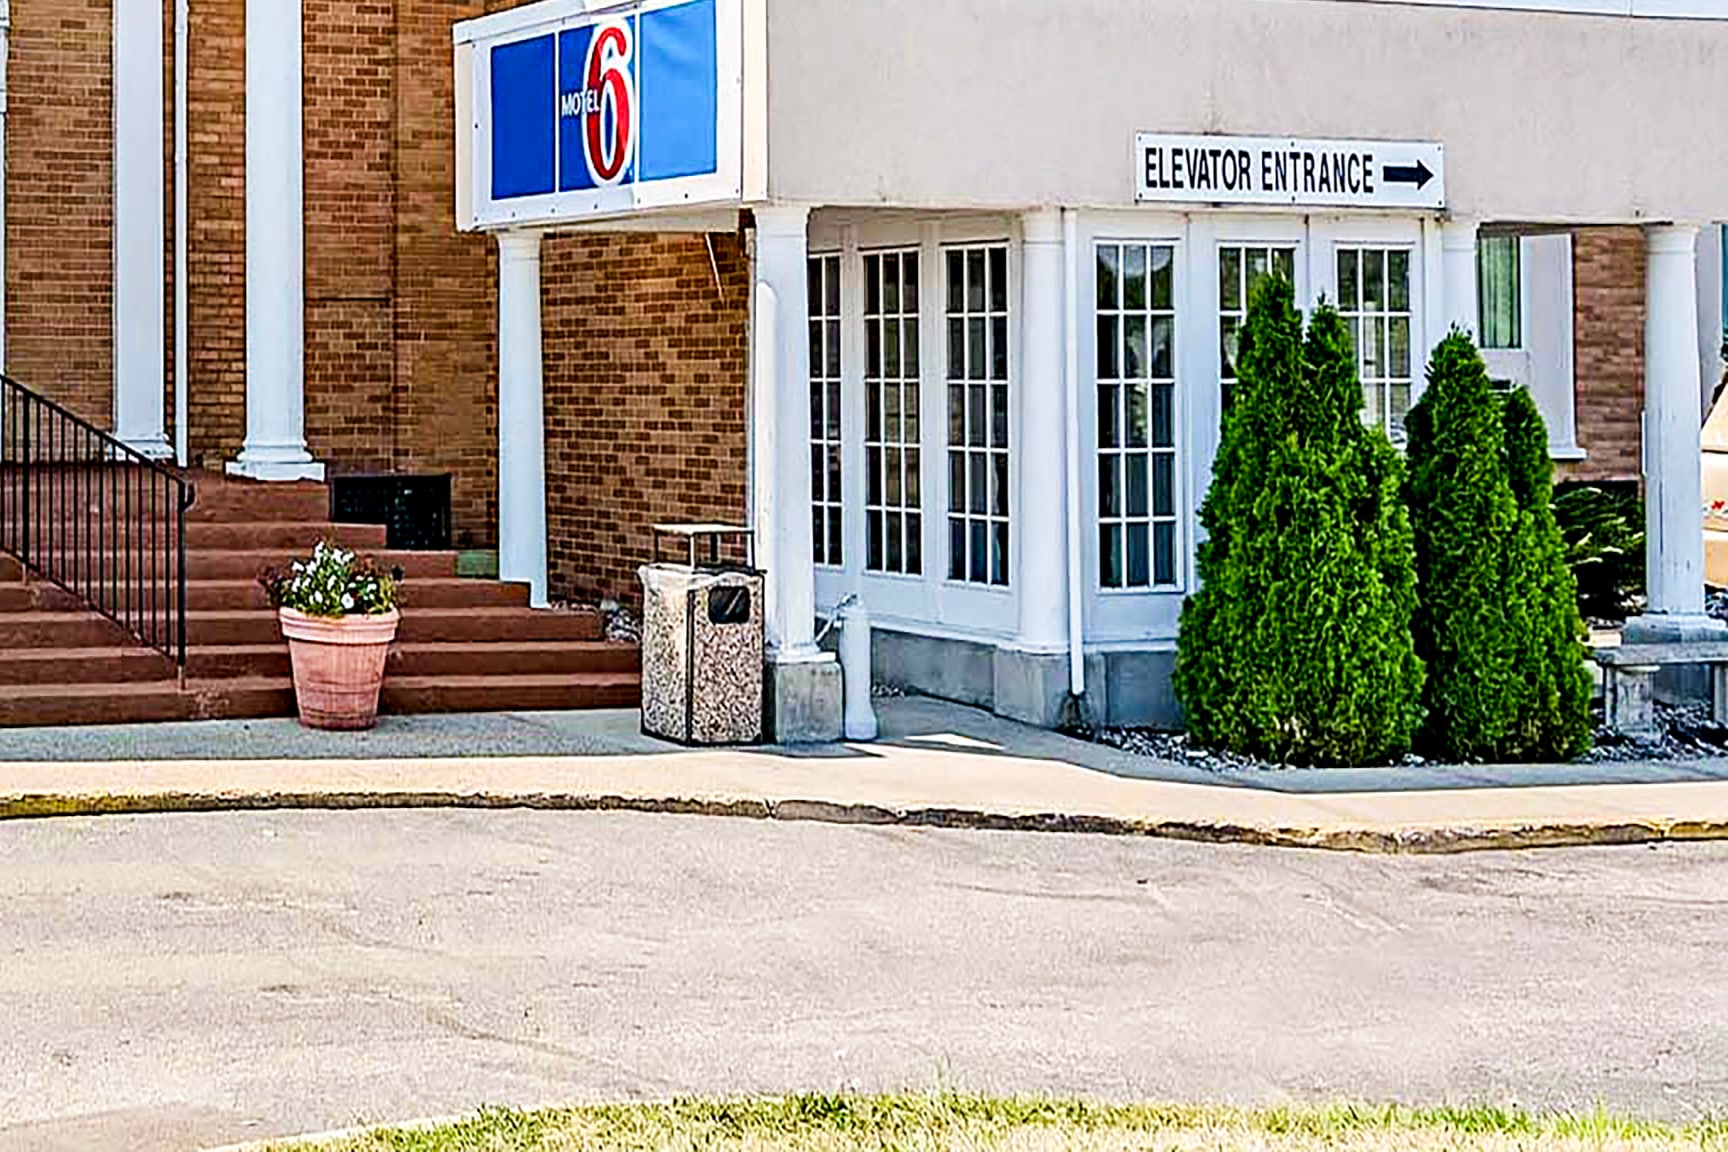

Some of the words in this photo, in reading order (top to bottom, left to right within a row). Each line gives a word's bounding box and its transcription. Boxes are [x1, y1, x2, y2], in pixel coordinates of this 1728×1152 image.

[561, 89, 600, 116] MOTEL
[584, 21, 632, 184] 6
[1144, 147, 1252, 191] ELEVATOR
[1261, 150, 1375, 194] ENTRANCE
